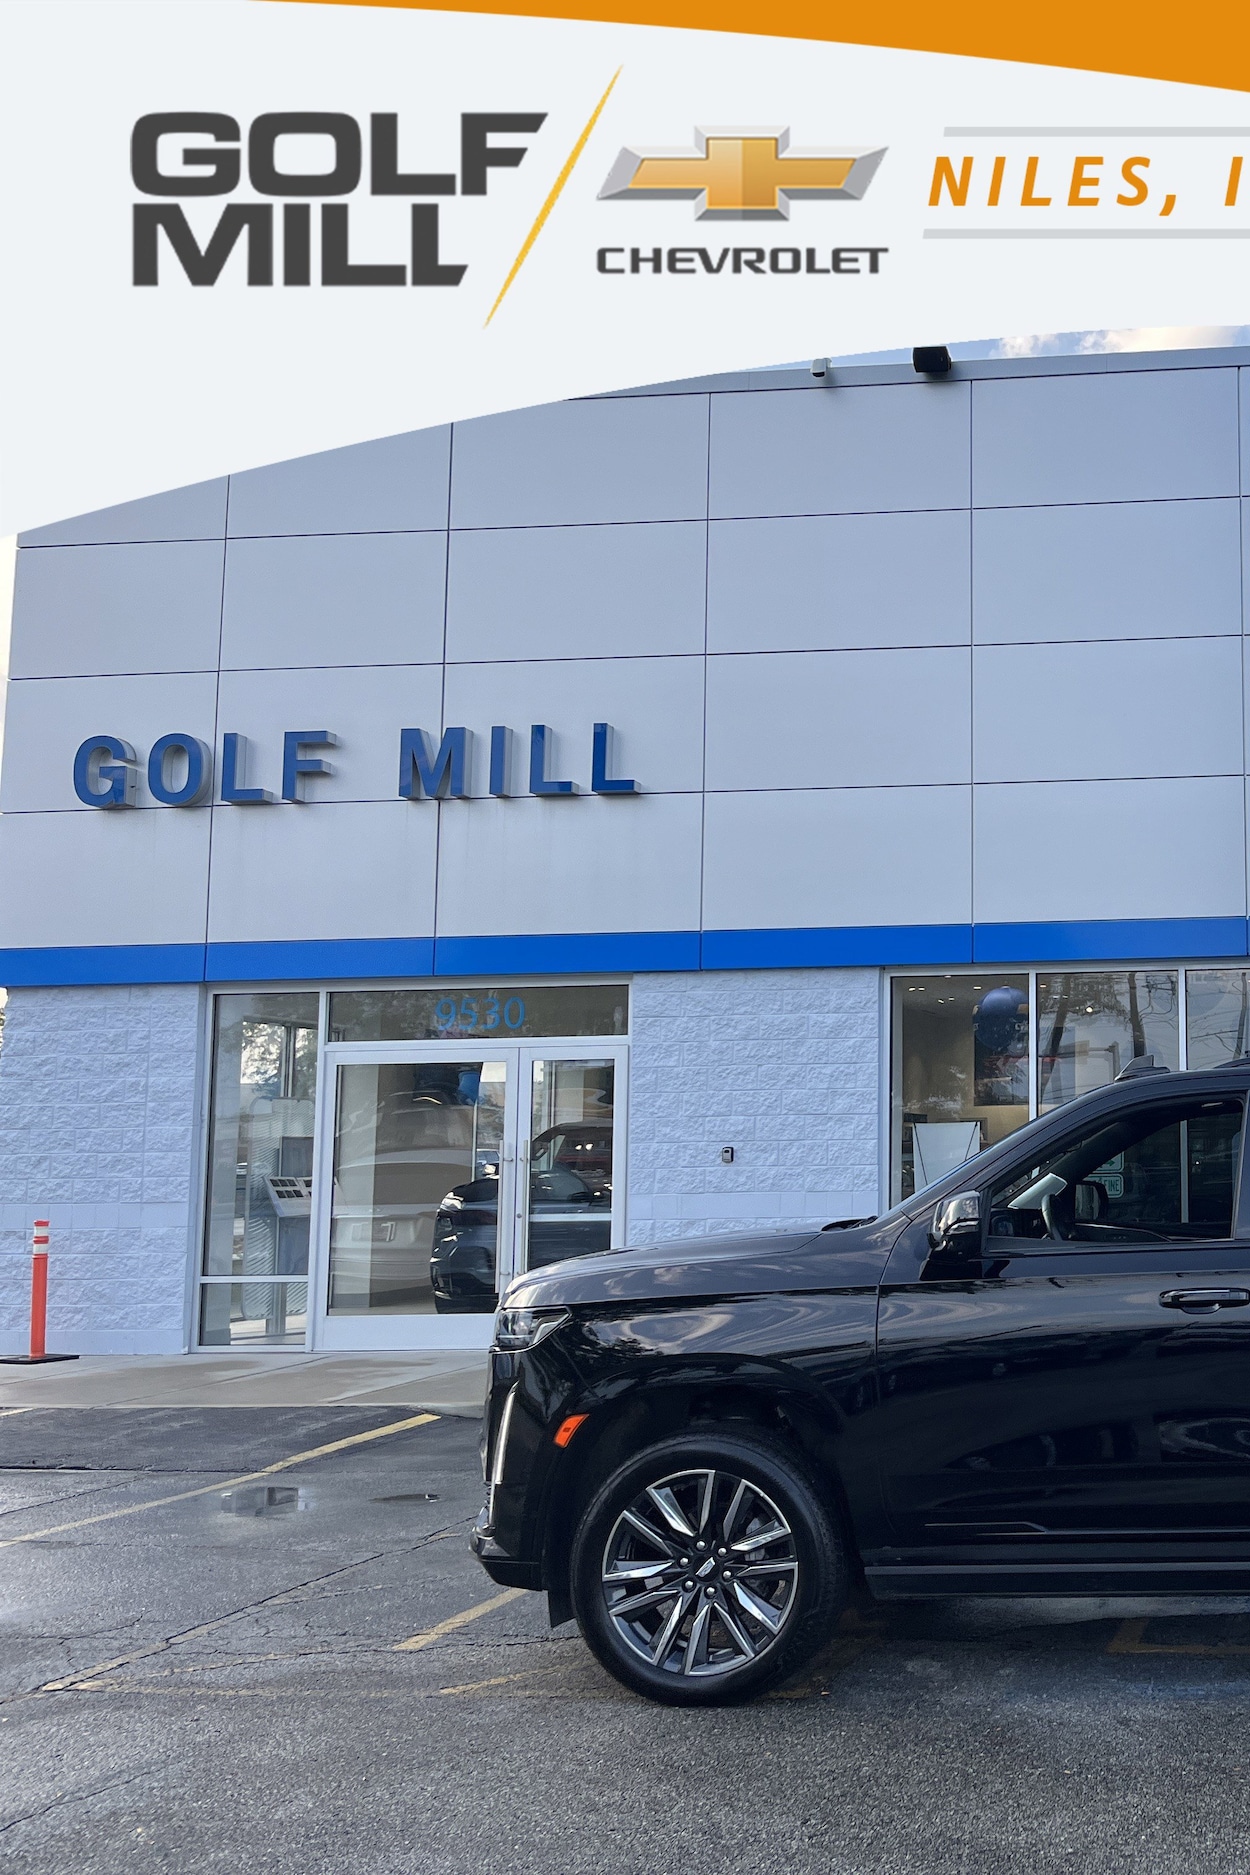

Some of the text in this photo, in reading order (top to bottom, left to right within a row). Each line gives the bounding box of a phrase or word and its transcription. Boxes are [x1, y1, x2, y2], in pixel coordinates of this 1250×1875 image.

[73, 722, 641, 809] GOLF MILL
[435, 996, 526, 1031] 9530
